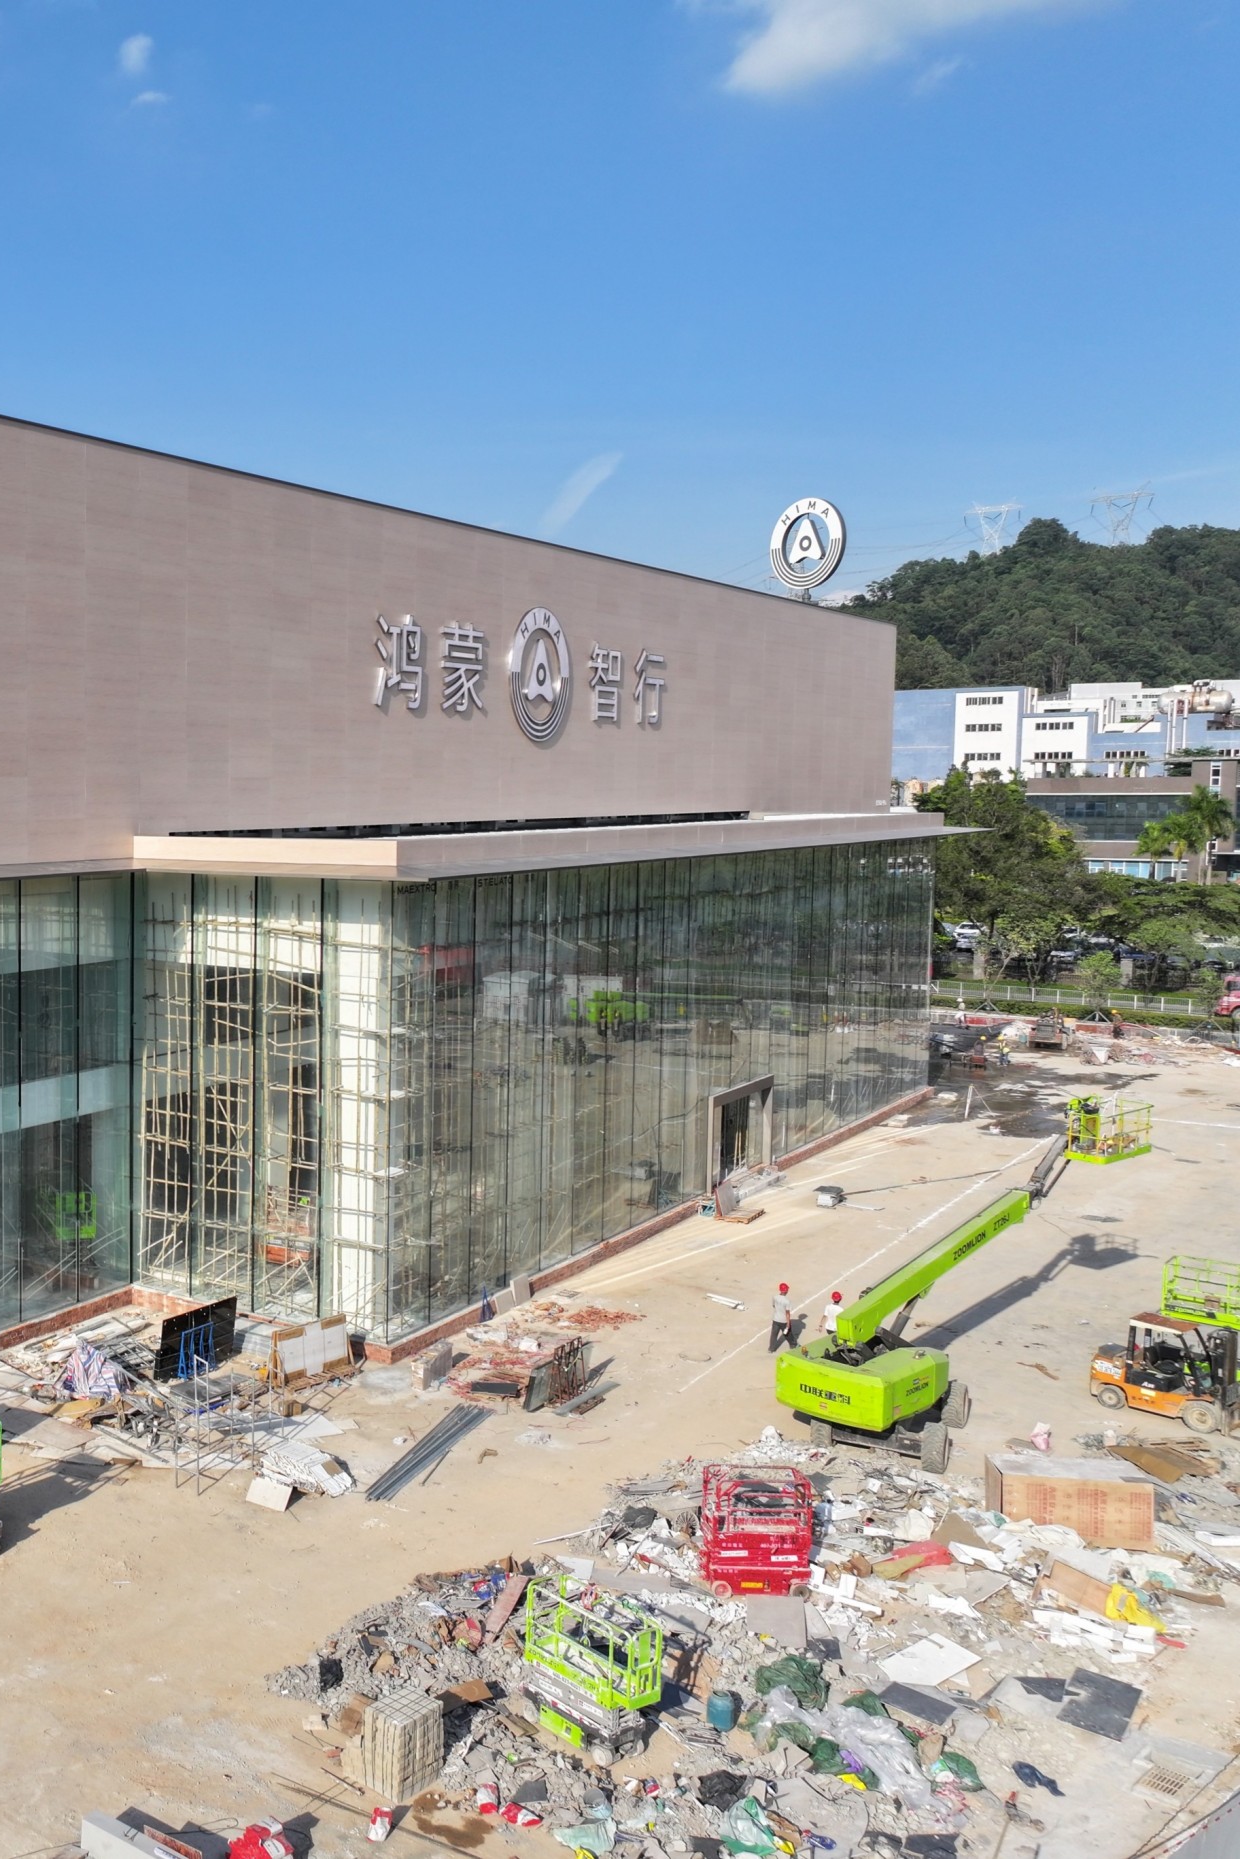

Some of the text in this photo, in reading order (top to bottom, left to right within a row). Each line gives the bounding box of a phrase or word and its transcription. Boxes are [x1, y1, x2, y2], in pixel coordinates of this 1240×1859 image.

[781, 500, 829, 526] HIMA
[519, 612, 562, 645] HIMA
[373, 614, 665, 724] 鸿蒙 智行
[397, 883, 436, 895] MAEXTRO
[477, 876, 513, 888] STELATO
[953, 1230, 986, 1261] ZOOMLION
[799, 1383, 851, 1405] 中联重科
[905, 1381, 929, 1397] ZOOMLION
